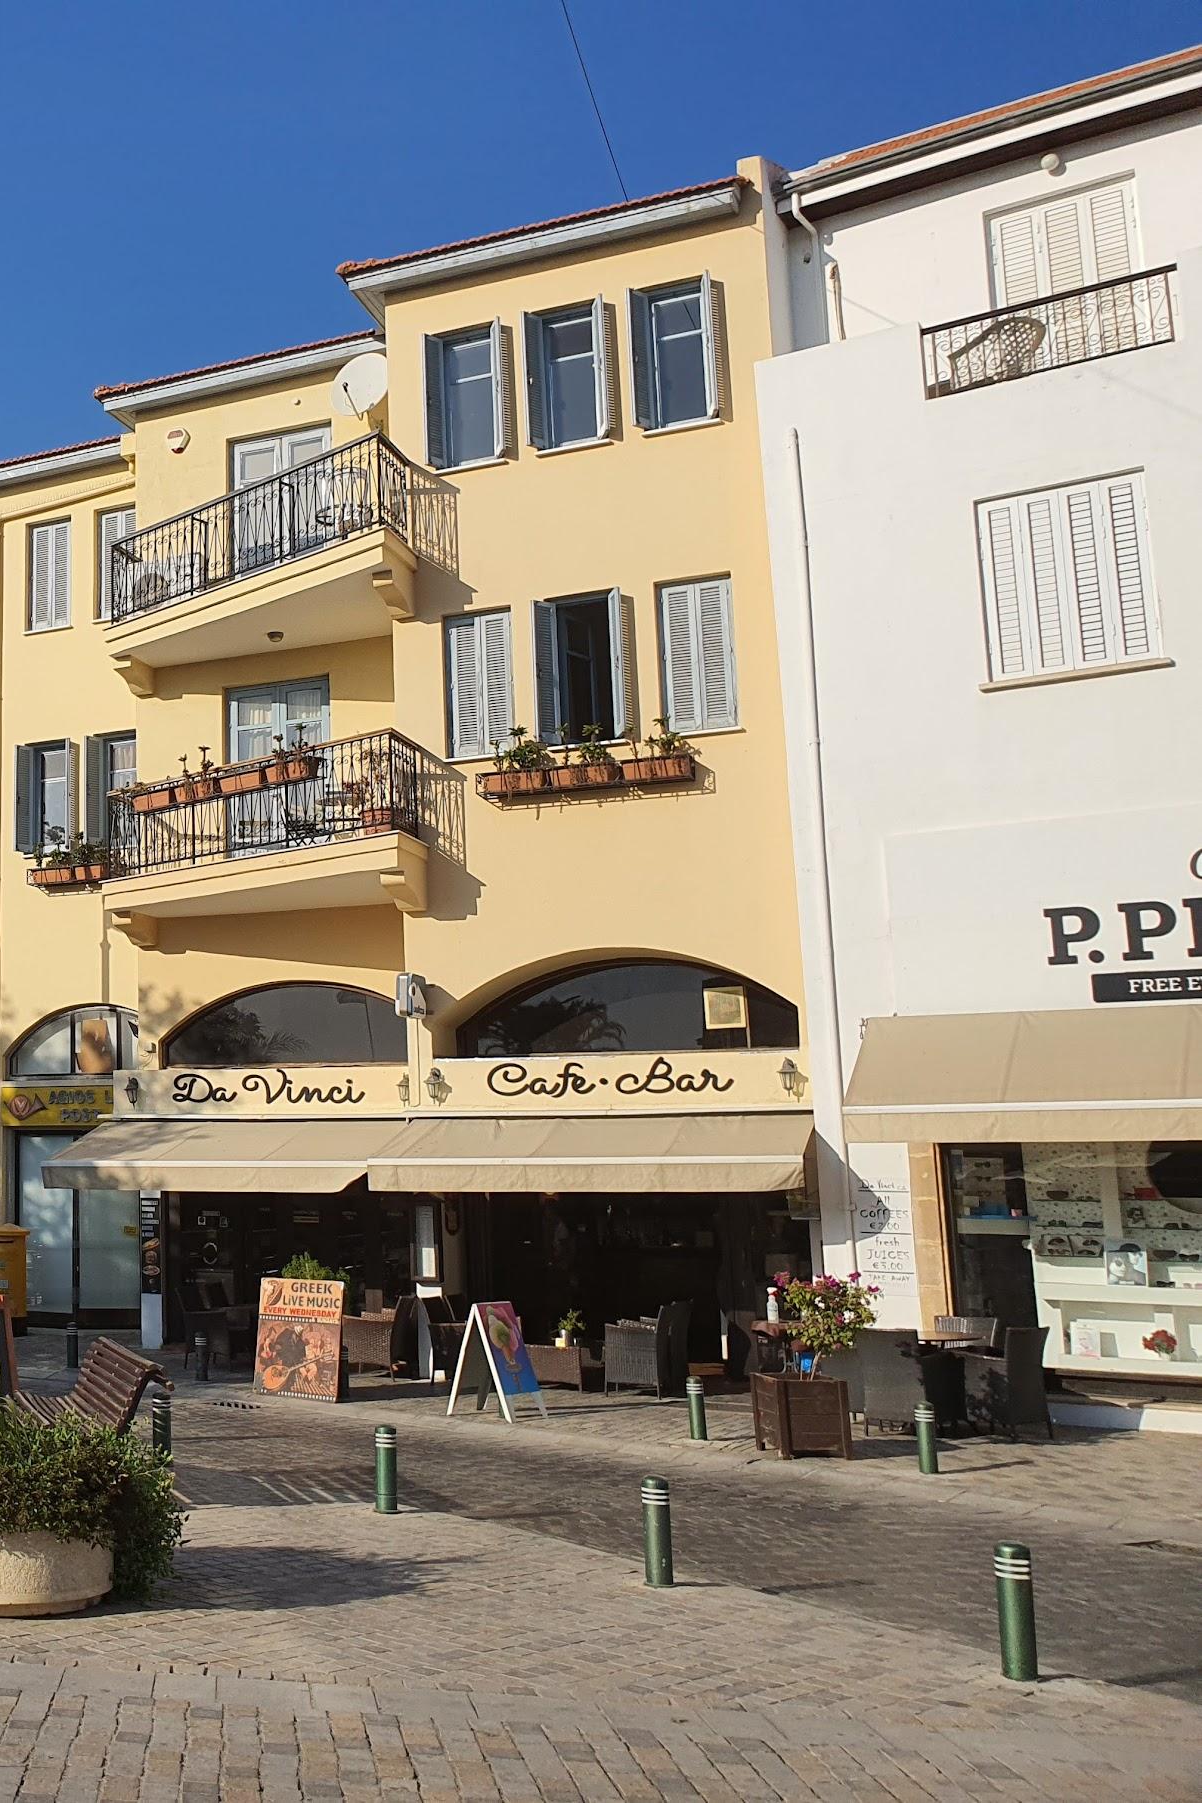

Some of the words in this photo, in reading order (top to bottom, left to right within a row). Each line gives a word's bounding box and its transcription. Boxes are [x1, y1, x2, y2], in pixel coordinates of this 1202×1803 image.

[1129, 977, 1183, 993] FREE
[487, 1062, 596, 1098] Cafe
[615, 1056, 734, 1095] Bar
[172, 1073, 237, 1103] Da
[242, 1068, 365, 1104] Vinci
[291, 1282, 333, 1294] GREEK
[306, 1297, 340, 1309] MUSIC
[263, 1306, 287, 1314] EVERY
[289, 1308, 337, 1318] WEDNESDAY
